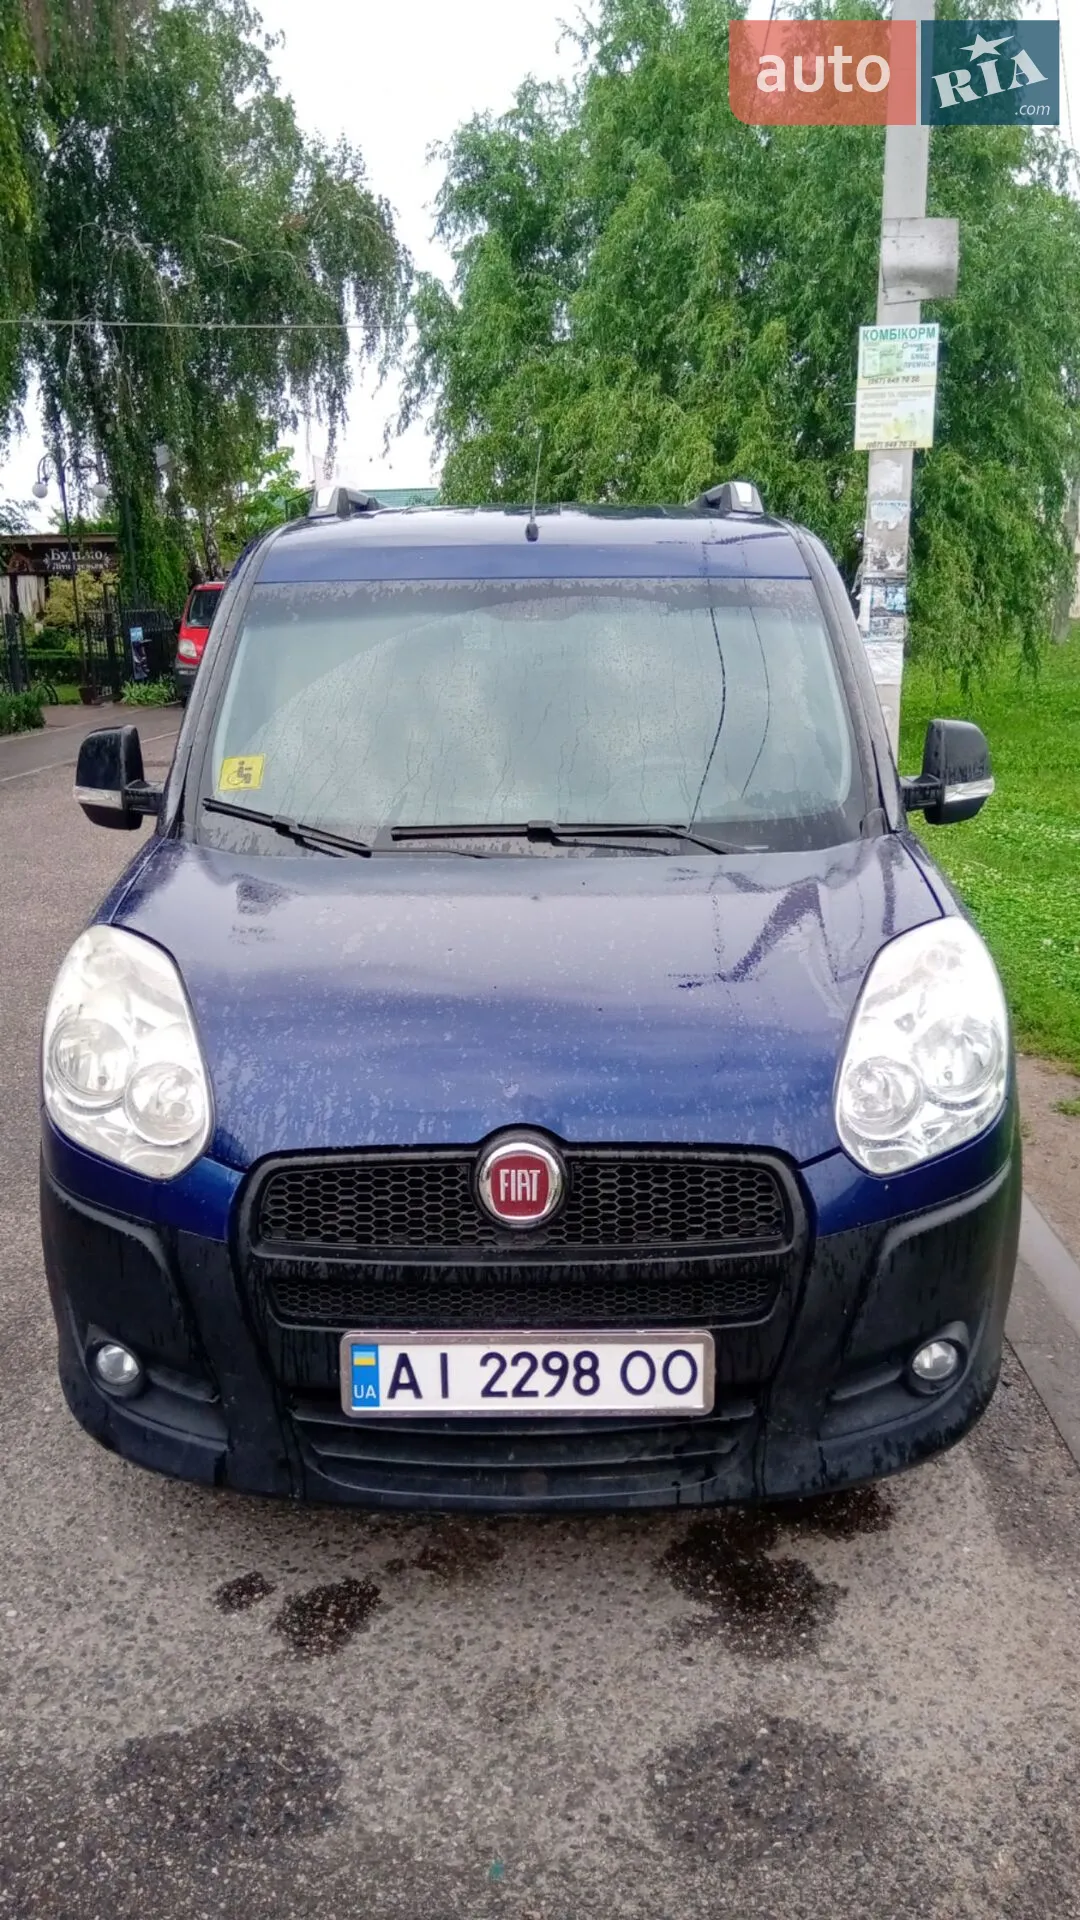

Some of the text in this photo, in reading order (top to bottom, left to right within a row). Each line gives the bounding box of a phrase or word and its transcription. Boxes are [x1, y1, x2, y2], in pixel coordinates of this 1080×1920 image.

[862, 326, 936, 341] КОМБІКОРМ
[500, 1169, 540, 1202] FIAT
[387, 1349, 698, 1399] AI 2298 OO
[353, 1385, 377, 1399] UA
